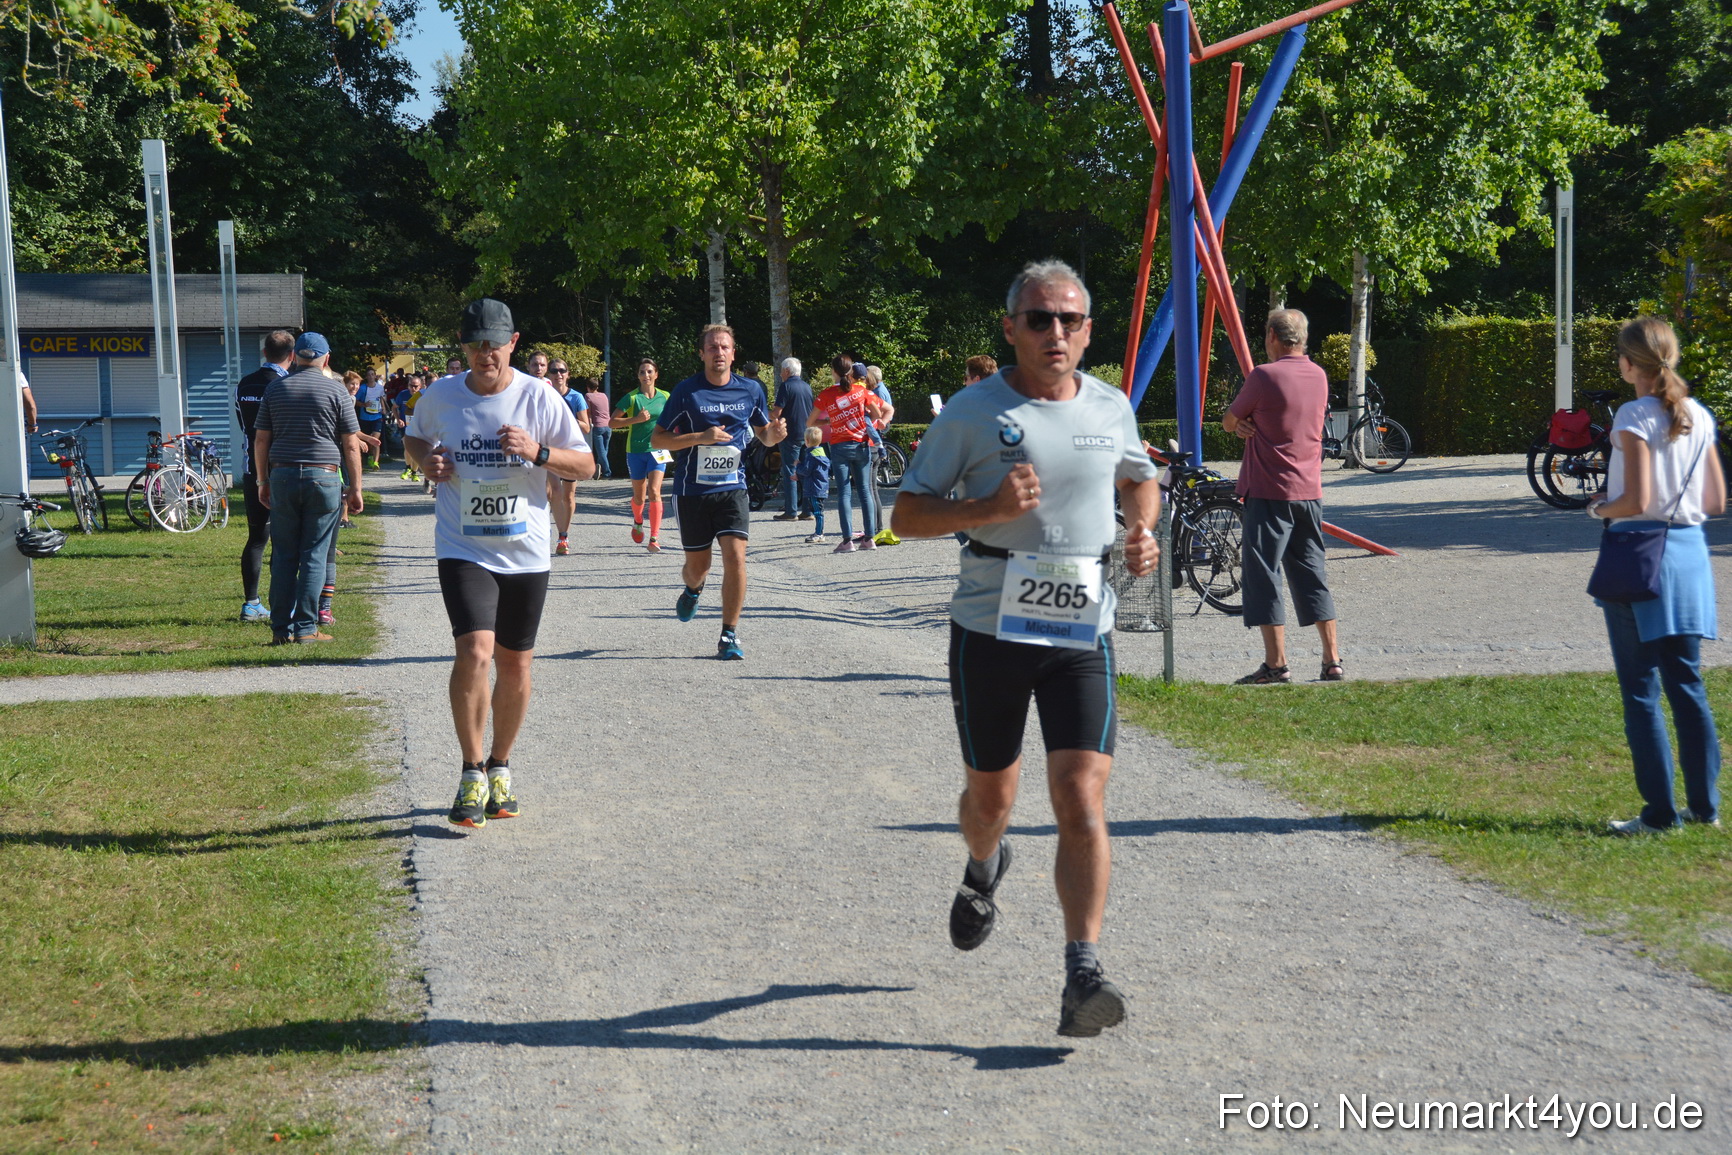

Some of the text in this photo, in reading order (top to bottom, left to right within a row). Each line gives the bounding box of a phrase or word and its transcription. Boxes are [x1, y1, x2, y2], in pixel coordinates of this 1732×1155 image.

[1072, 435, 1115, 449] BOCK
[704, 456, 734, 470] 2626
[470, 494, 519, 516] 2607
[482, 526, 510, 535] Martin
[1041, 524, 1069, 543] 19.
[1017, 577, 1089, 609] 2265
[1024, 620, 1072, 637] Michael
